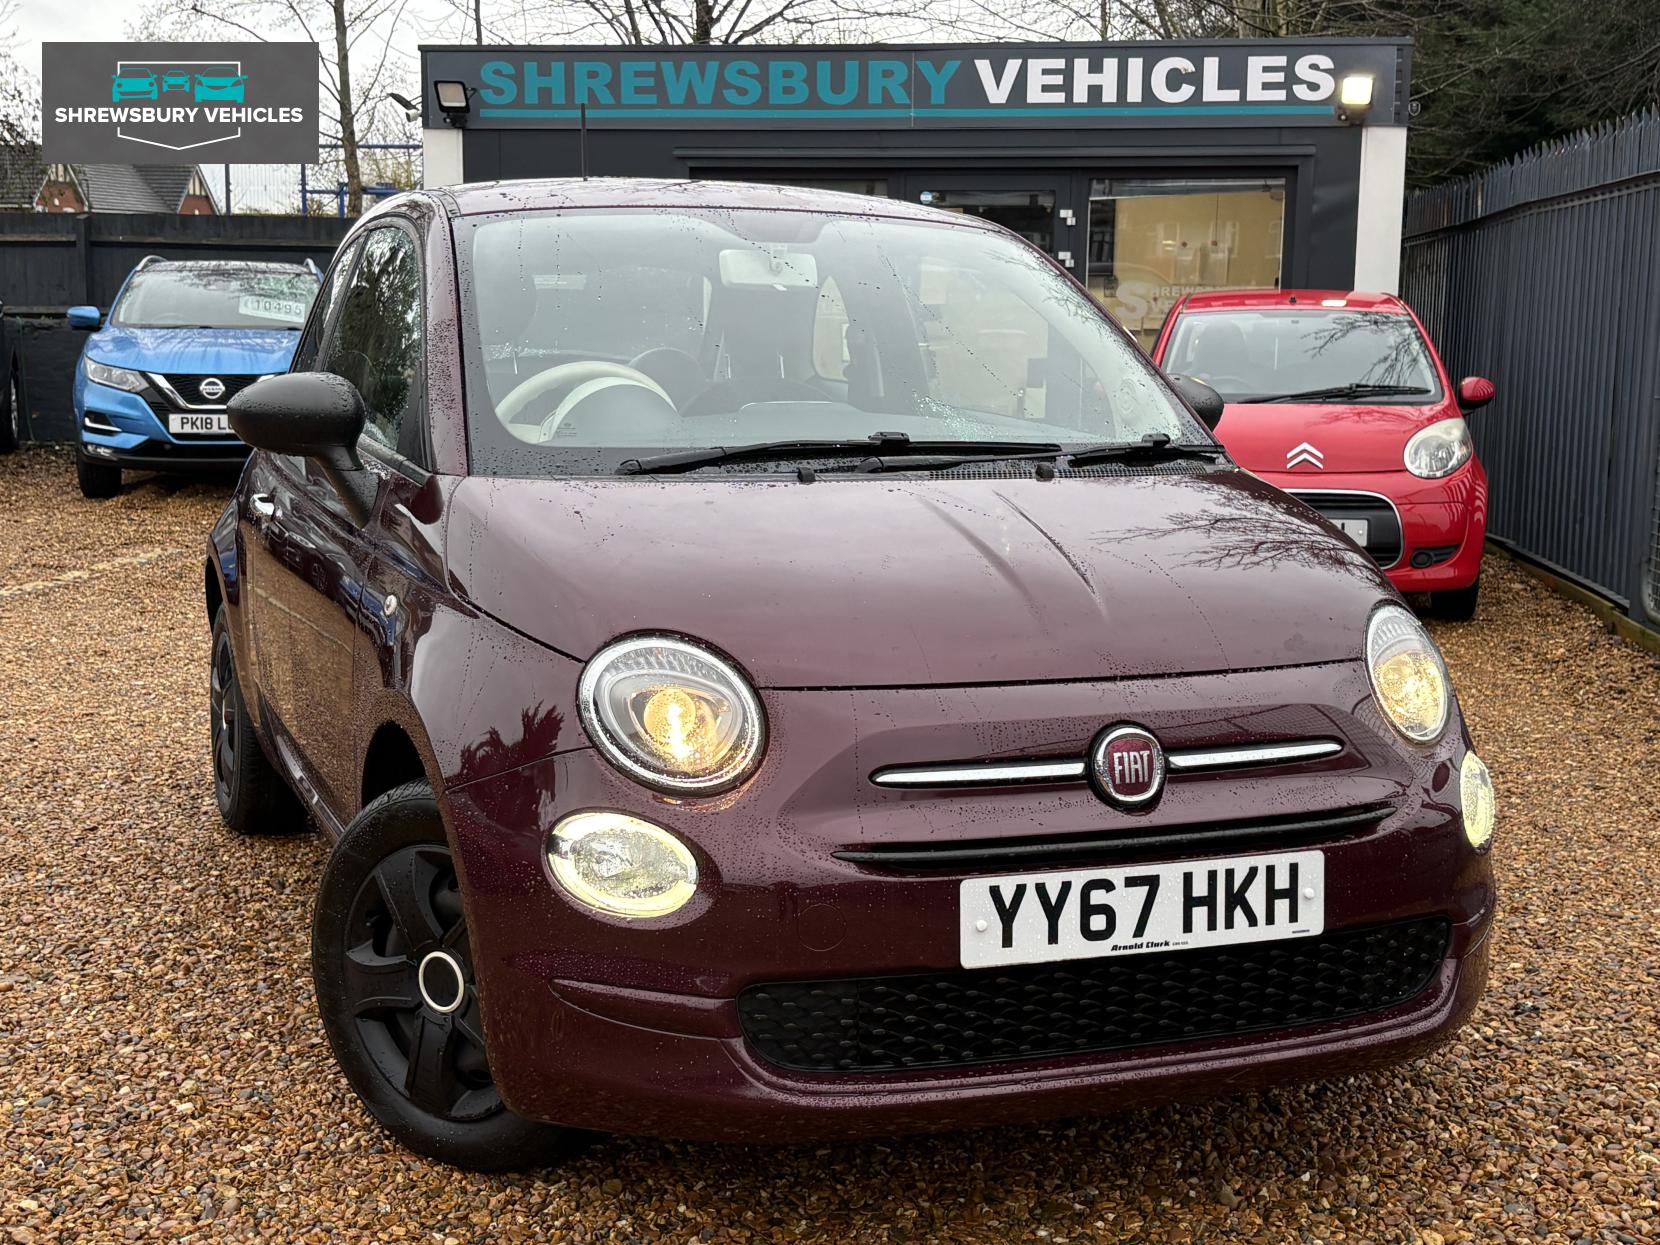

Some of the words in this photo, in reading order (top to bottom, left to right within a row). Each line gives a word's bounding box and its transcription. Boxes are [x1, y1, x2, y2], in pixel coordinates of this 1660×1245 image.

[479, 60, 962, 105] SHREWSBURY
[974, 54, 1336, 104] VEHICLES
[181, 416, 213, 431] PK18
[1113, 750, 1150, 785] FIAT
[988, 874, 1161, 948] YY67
[1182, 862, 1299, 934] HKH
[1111, 942, 1143, 951] Arnold
[1146, 940, 1170, 948] Clark
